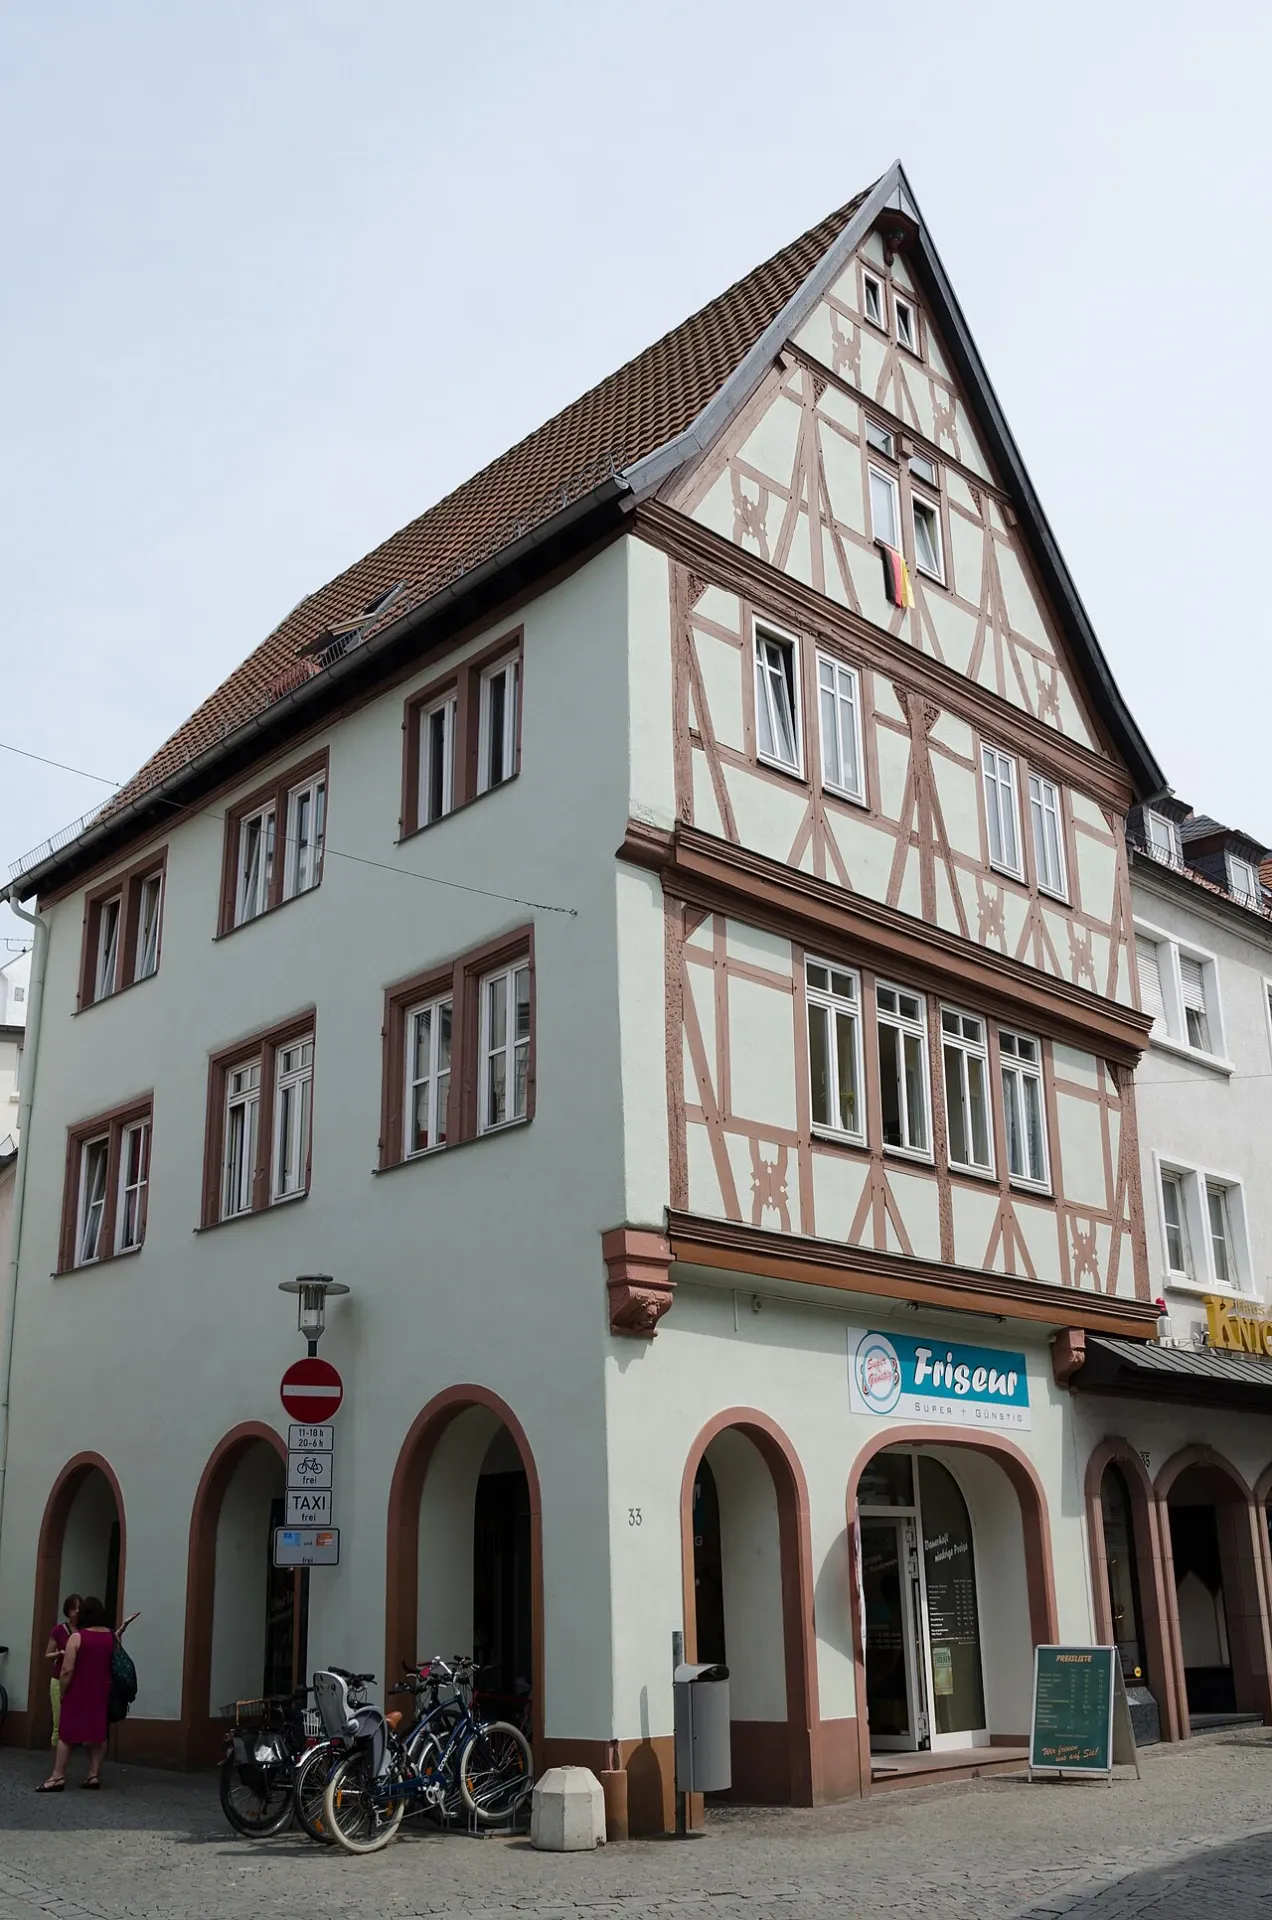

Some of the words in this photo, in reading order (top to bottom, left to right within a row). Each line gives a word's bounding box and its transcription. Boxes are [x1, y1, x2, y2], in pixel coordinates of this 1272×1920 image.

[914, 1347, 1018, 1396] Friseur
[975, 1408, 1023, 1422] GÜNSTIG
[298, 1428, 318, 1437] 11-18
[319, 1429, 324, 1437] h
[298, 1438, 318, 1447] 20-6
[318, 1439, 324, 1447] h
[302, 1475, 317, 1484] frei
[292, 1496, 326, 1510] TAXI
[301, 1512, 316, 1522] frei
[628, 1508, 643, 1527] 33
[302, 1556, 314, 1564] frei
[1055, 1654, 1093, 1663] PREISLISTE
